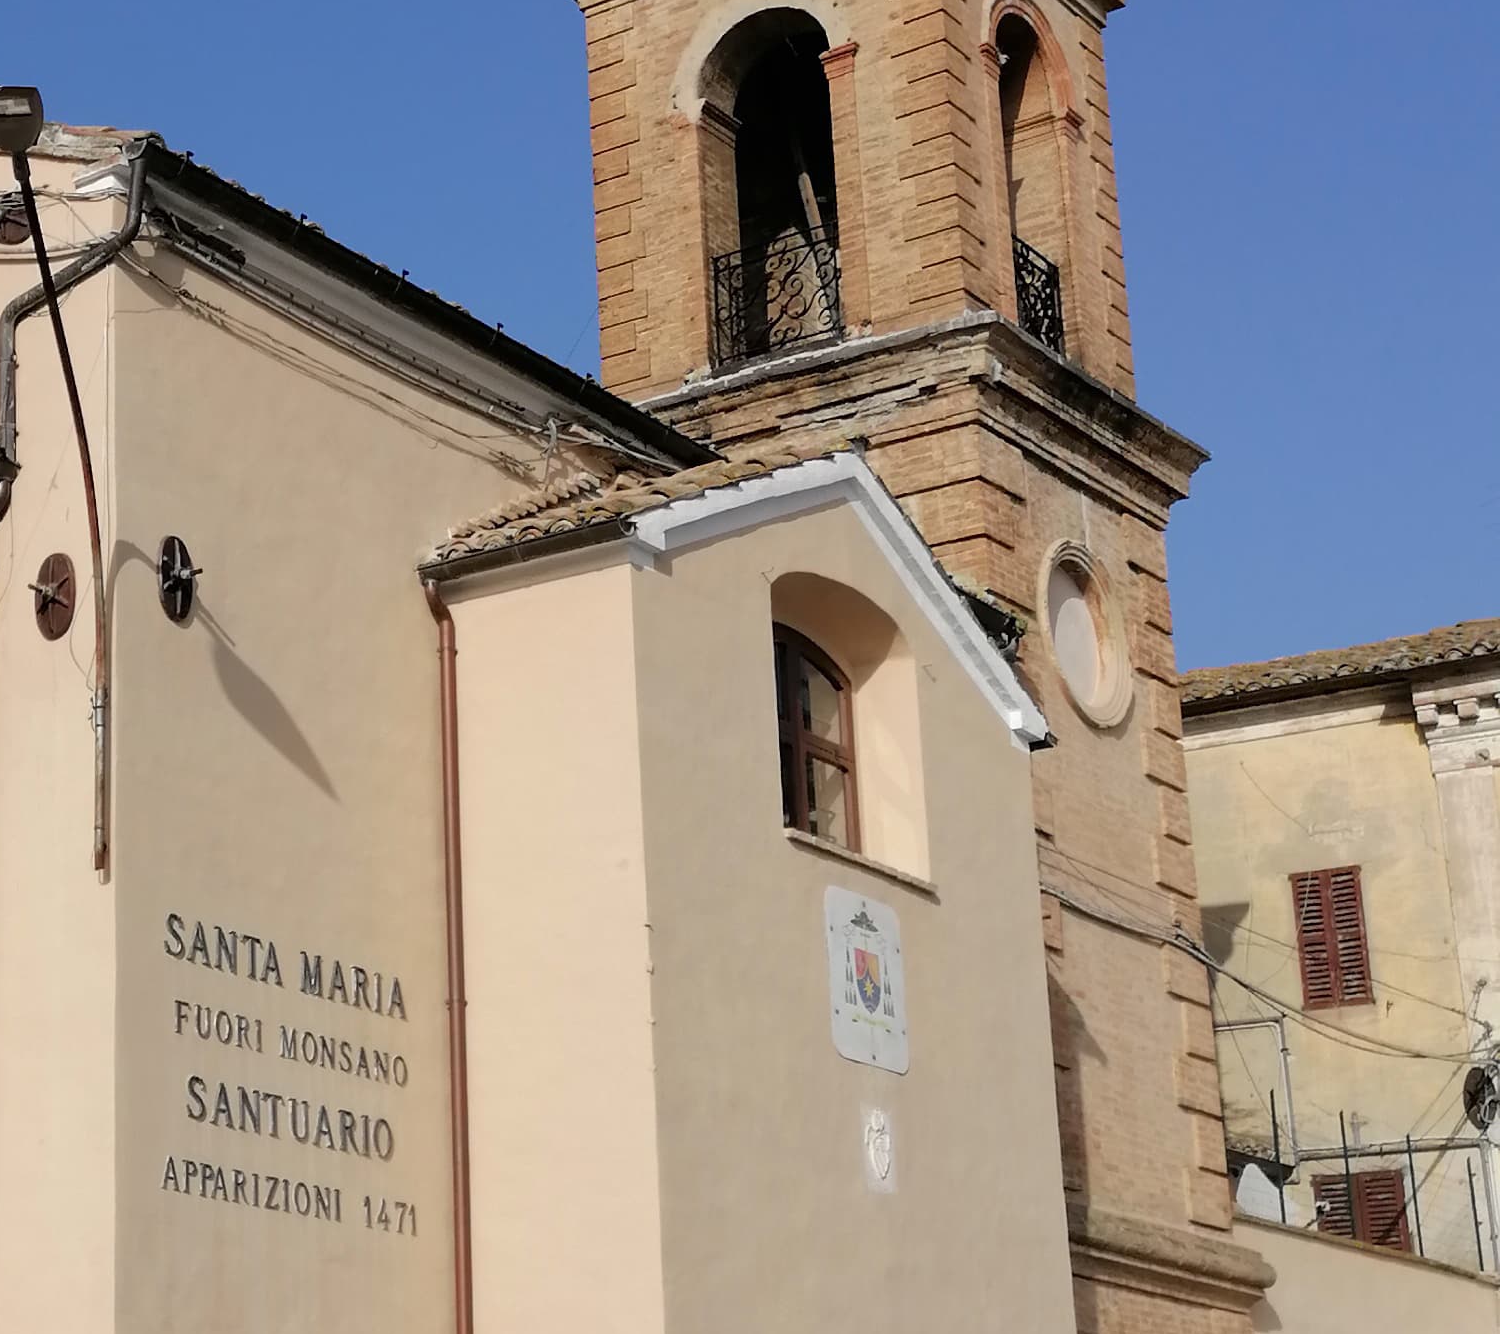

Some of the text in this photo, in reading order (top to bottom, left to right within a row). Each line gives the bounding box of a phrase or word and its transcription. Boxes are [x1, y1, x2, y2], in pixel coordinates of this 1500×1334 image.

[163, 913, 409, 1022] SANTA MARIA
[173, 999, 409, 1089] FUORI MONSANO
[186, 1075, 395, 1163] SANTUARIO
[161, 1155, 419, 1237] APPARIZIONI 1471
